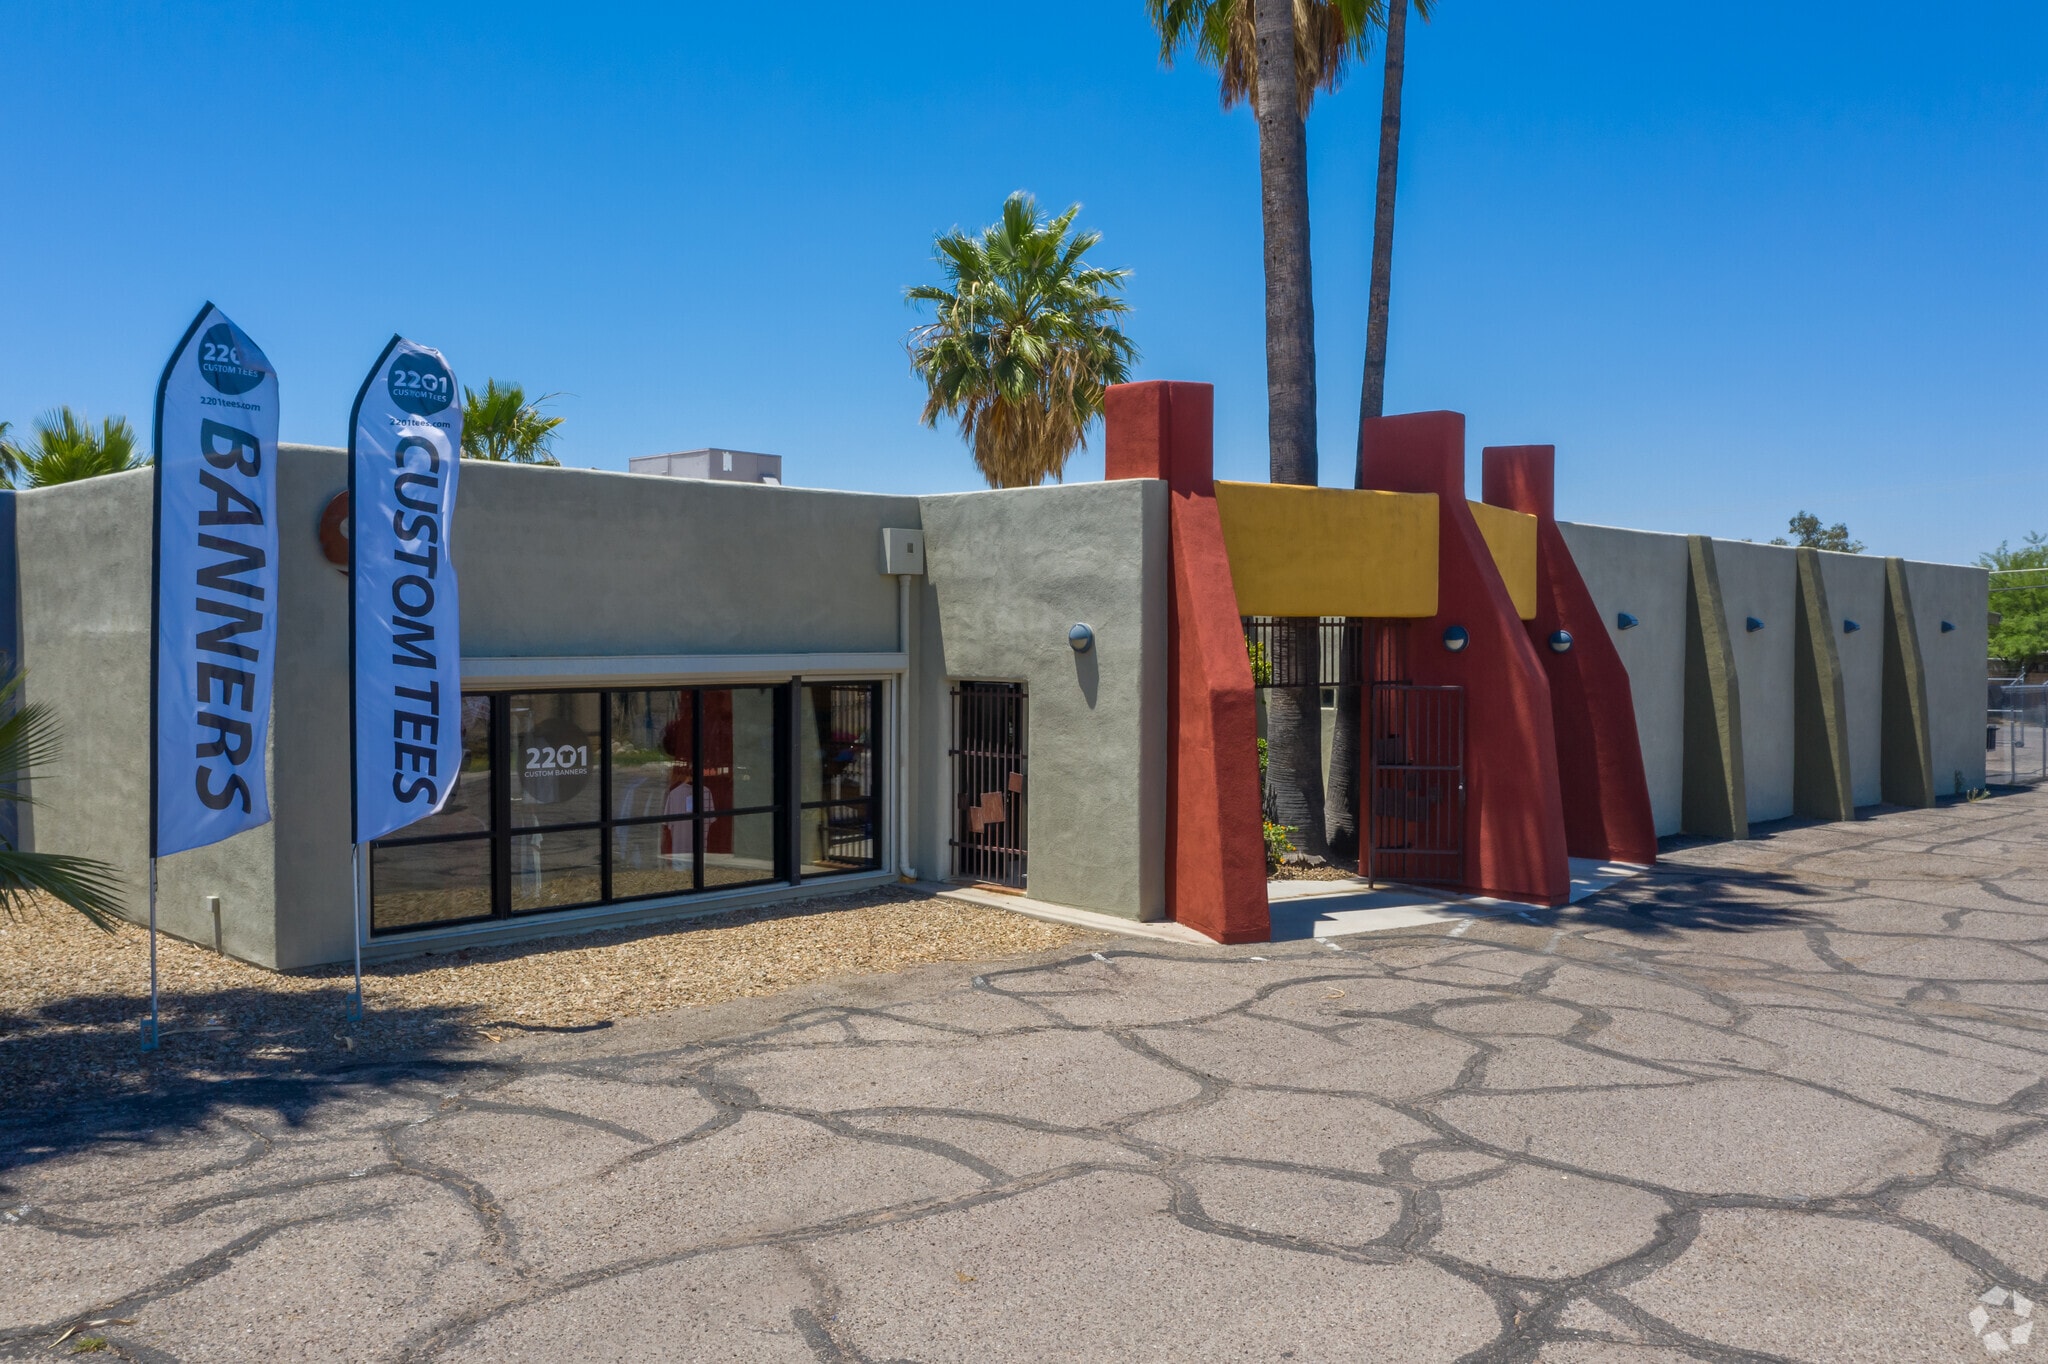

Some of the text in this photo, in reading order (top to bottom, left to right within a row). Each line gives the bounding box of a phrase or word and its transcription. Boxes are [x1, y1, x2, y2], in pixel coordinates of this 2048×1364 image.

[203, 363, 259, 378] CUSTOM TEES
[394, 369, 448, 394] 2201
[200, 396, 260, 411] 2201tees.com
[393, 388, 447, 403] CUSTOM TEES
[389, 418, 450, 428] 2201tees.com
[196, 417, 266, 815] BANNERS
[392, 435, 440, 806] CUSTOM TEES
[526, 744, 587, 769] 2201
